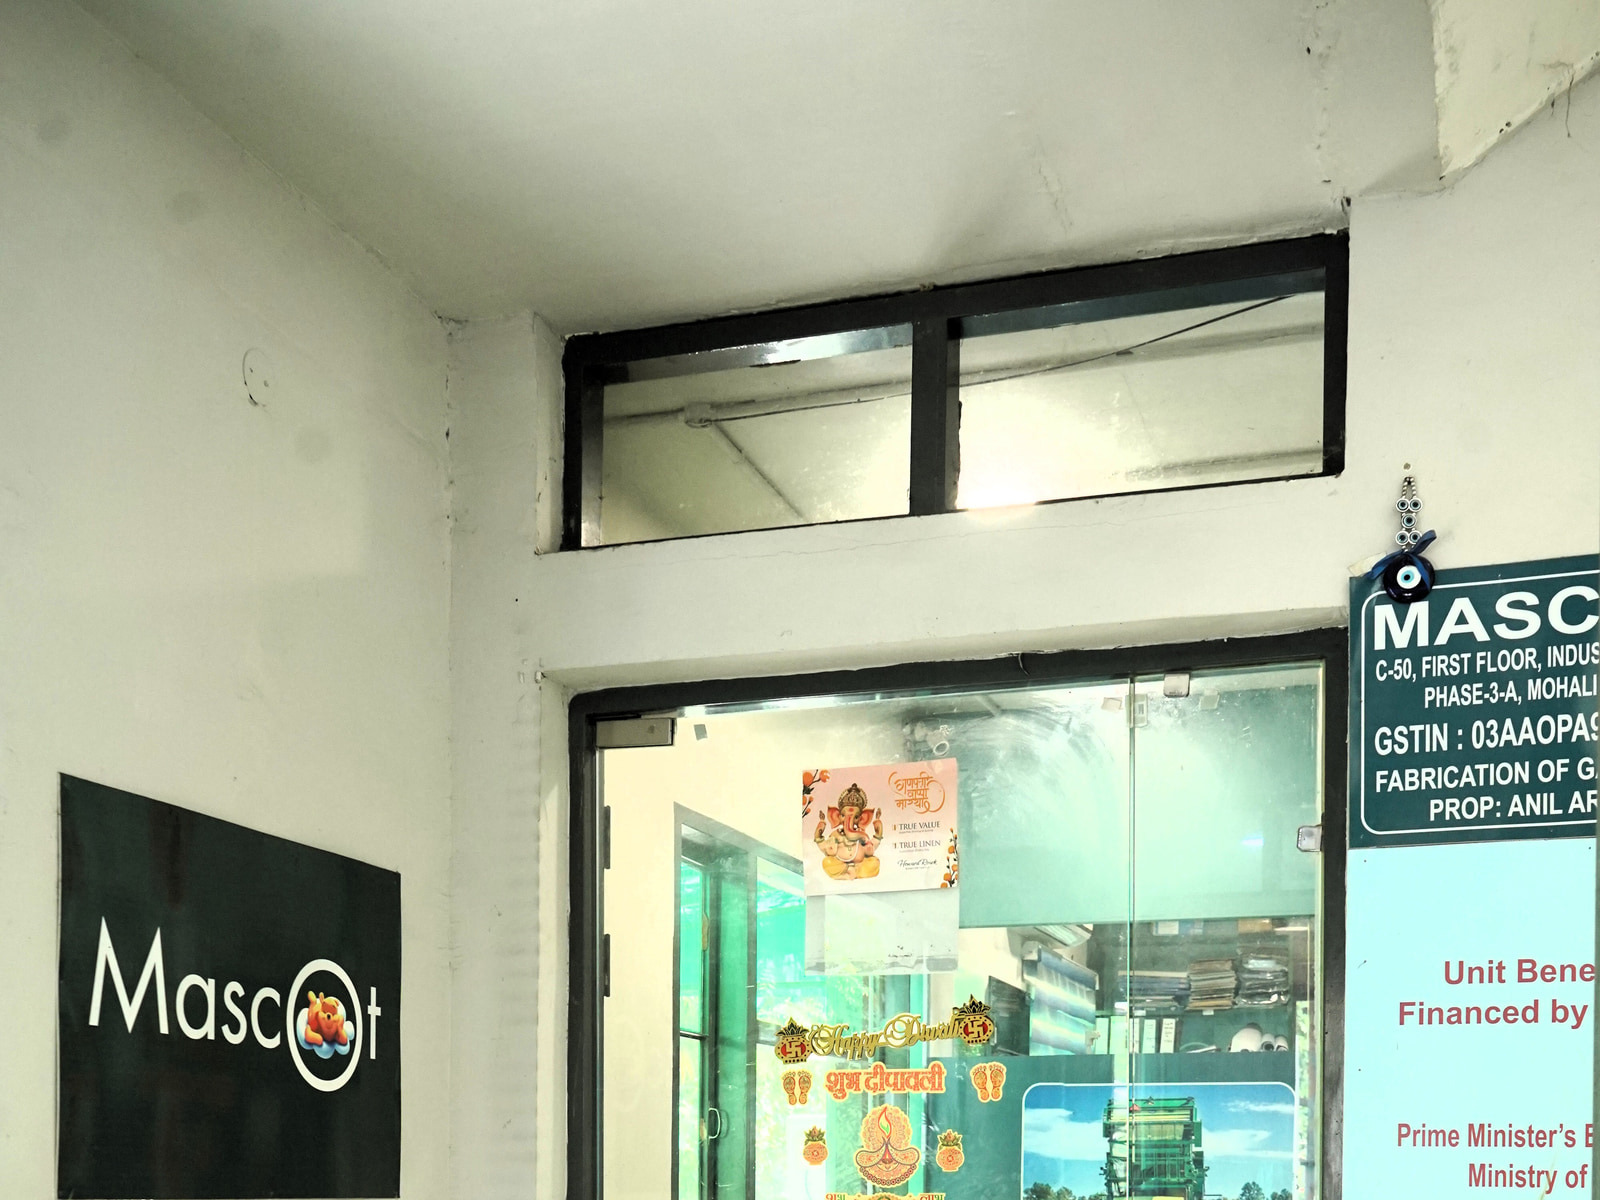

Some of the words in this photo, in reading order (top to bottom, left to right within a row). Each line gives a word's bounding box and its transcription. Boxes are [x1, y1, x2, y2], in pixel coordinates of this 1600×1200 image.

[1374, 585, 1599, 650] MASC
[1375, 658, 1417, 682] C-50,
[1421, 653, 1471, 677] FIRST
[1476, 647, 1541, 673] FLOOR,
[1547, 642, 1599, 667] INDUS
[1424, 680, 1521, 708] PHASE-3-A,
[1527, 674, 1598, 700] MOHALI
[1374, 723, 1448, 756] GSTIN
[1457, 728, 1463, 750] :
[1375, 761, 1529, 793] FABRICATION
[1537, 758, 1570, 783] OF
[1577, 756, 1598, 780] G
[1429, 796, 1501, 822] PROP:
[1507, 792, 1563, 817] ANIL
[899, 823, 917, 831] TRUE
[918, 820, 941, 830] VALUE
[899, 841, 918, 849] TRUE
[919, 839, 941, 848] LINEN
[1444, 959, 1506, 985] Unit
[1517, 958, 1595, 983] Bene
[1399, 998, 1539, 1026] Financed
[1551, 998, 1589, 1030] by
[811, 1024, 884, 1060] Happy
[825, 1071, 862, 1100] शुभ
[863, 1062, 945, 1093] दीपावली
[1397, 1123, 1460, 1148] Prime
[1468, 1163, 1557, 1195] Ministry
[1565, 1163, 1589, 1189] of
